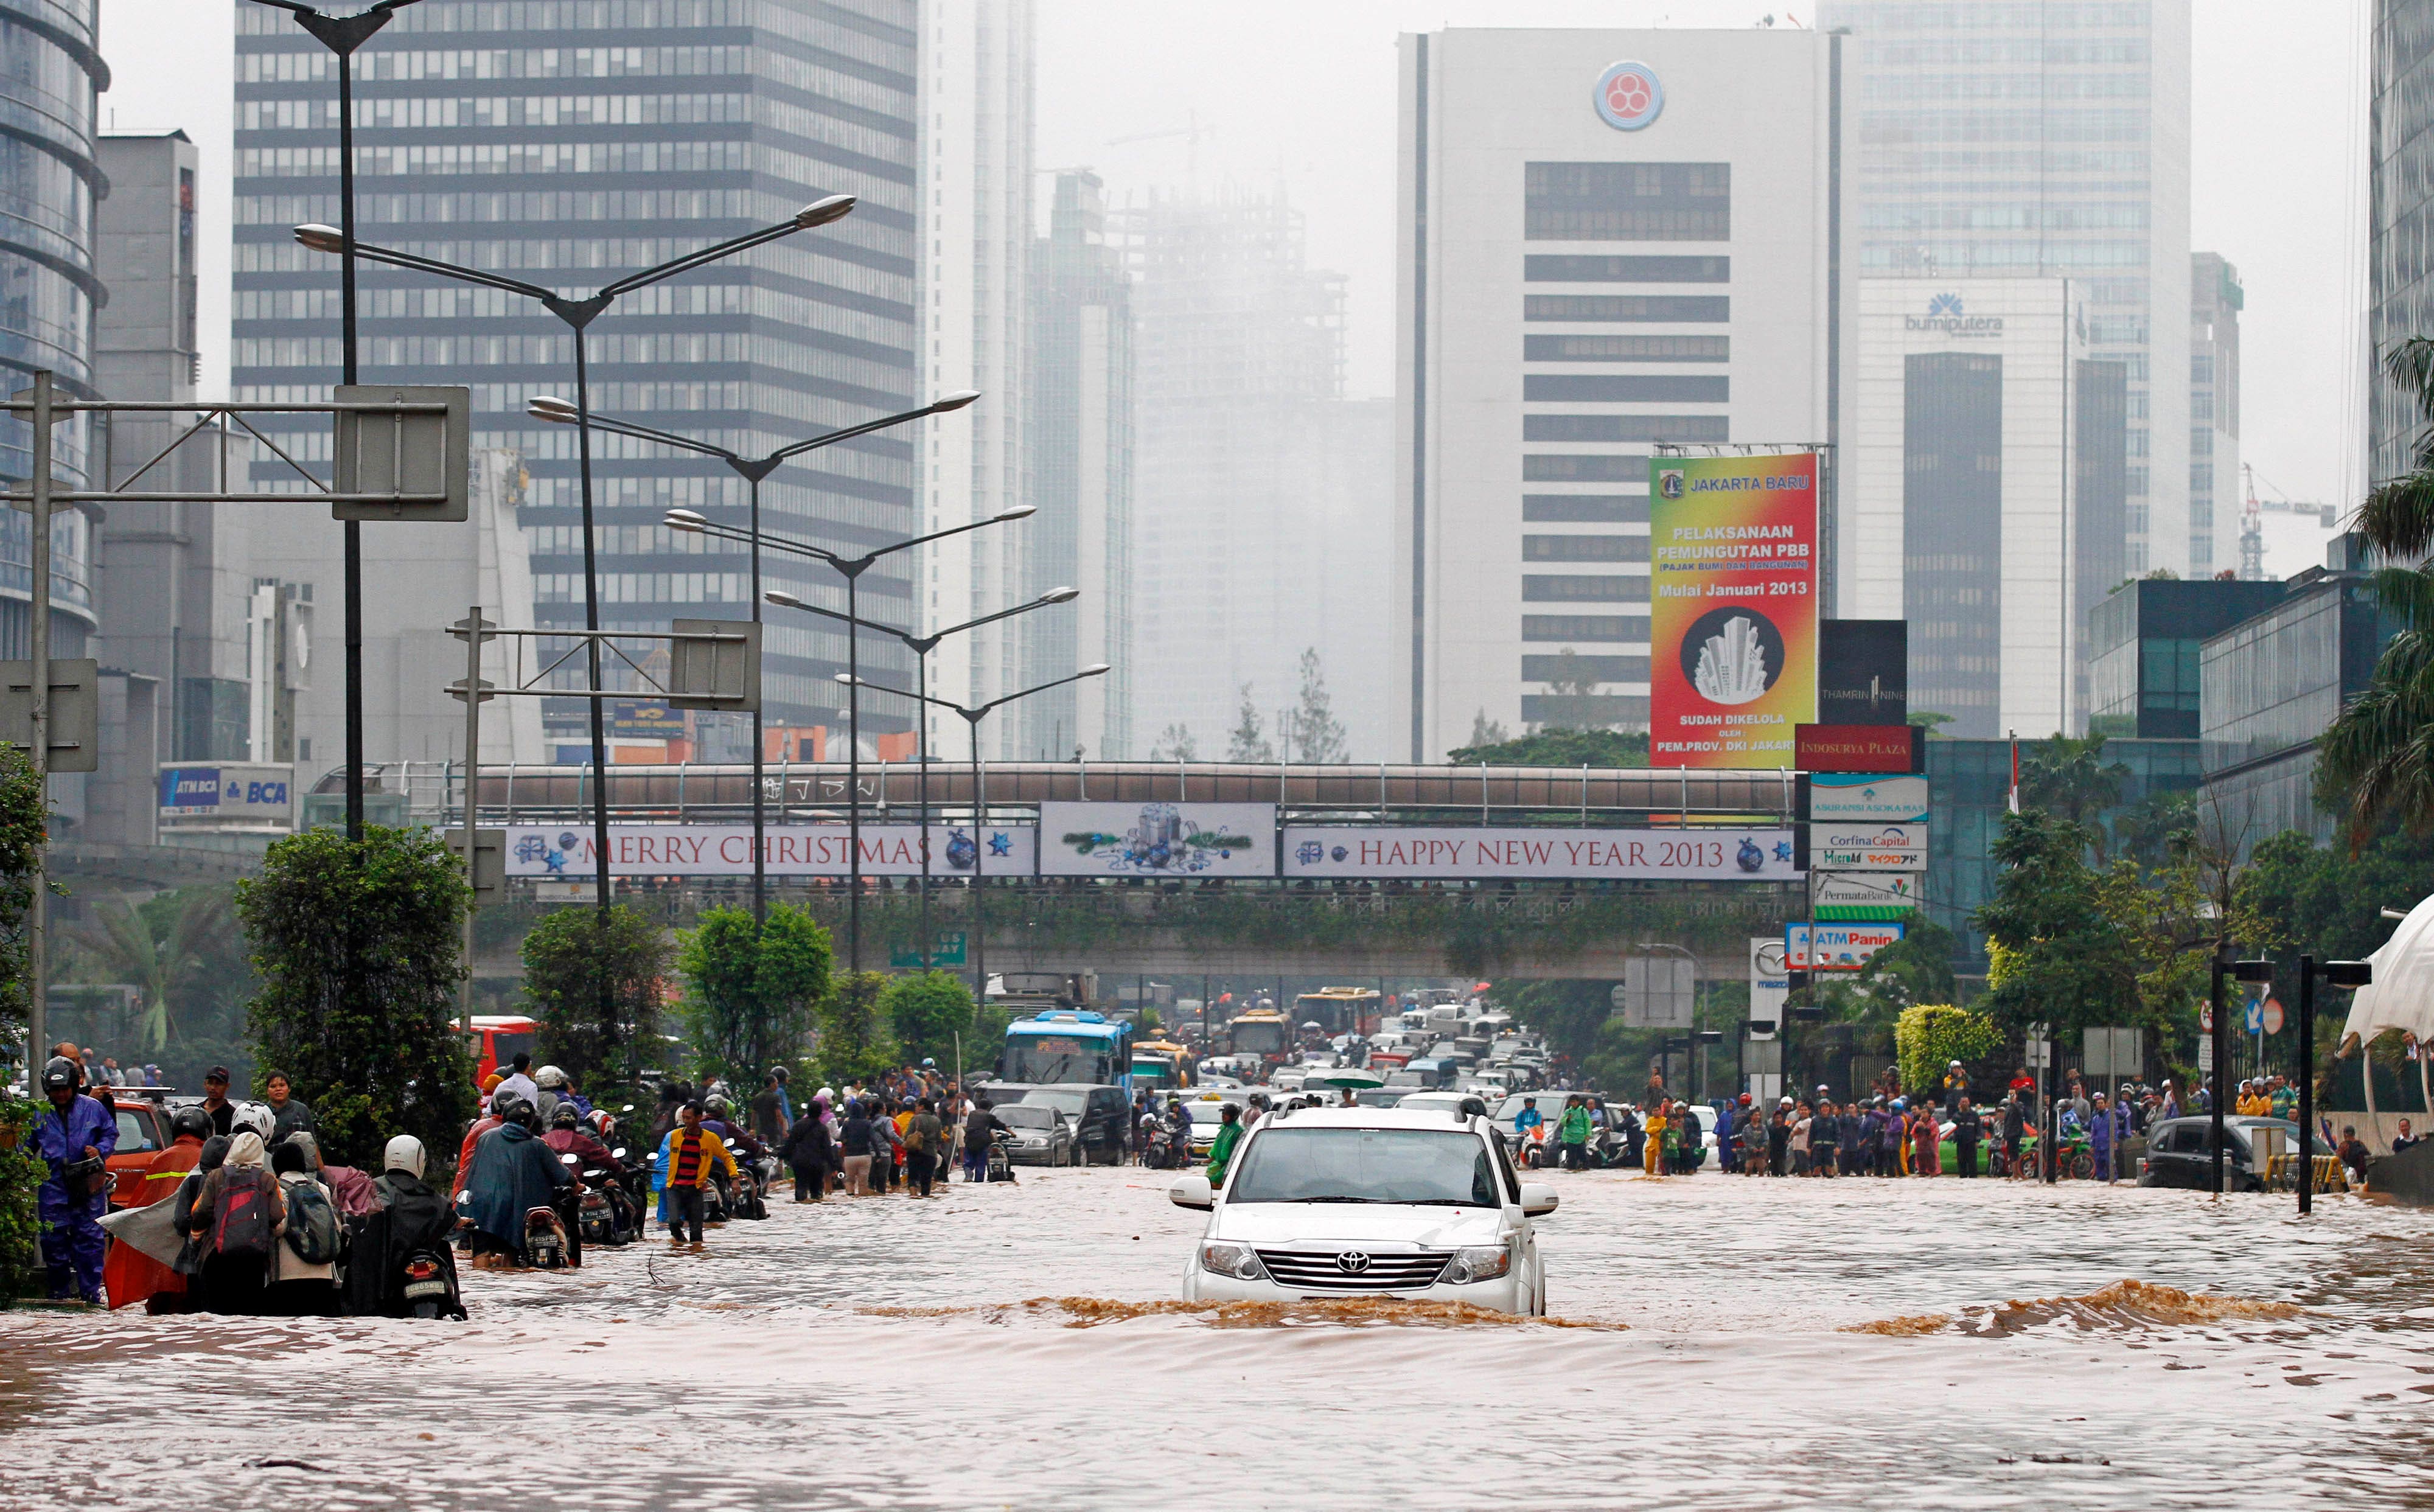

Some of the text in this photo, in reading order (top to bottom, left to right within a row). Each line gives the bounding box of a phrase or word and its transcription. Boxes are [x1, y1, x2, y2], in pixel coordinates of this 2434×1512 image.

[1905, 315, 2003, 332] bumiputera
[1691, 476, 1809, 492] JAKARTA BARU
[1674, 525, 1794, 540] PELAKSANAAN
[1658, 544, 1809, 559] PEMUNGUTAN PBB
[1659, 562, 1695, 571] (PAJAK
[1698, 562, 1723, 570] BUMI
[1749, 560, 1808, 570] BANGUNAN)
[1660, 582, 1807, 597] Mulai Januari 2013
[1822, 689, 1906, 700] THAMRIN NINE
[1680, 714, 1785, 725] SUDAH DIKELOLA
[1726, 742, 1746, 750] DKI
[1869, 743, 1908, 754] PLAZA
[176, 780, 217, 793] ATM BCA
[246, 782, 287, 804] BCA
[584, 837, 932, 864] MERRY CHRISTMAS
[1361, 840, 1723, 867] HAPPY NEW YEAR 2013
[1867, 855, 1917, 864] マイクロアド
